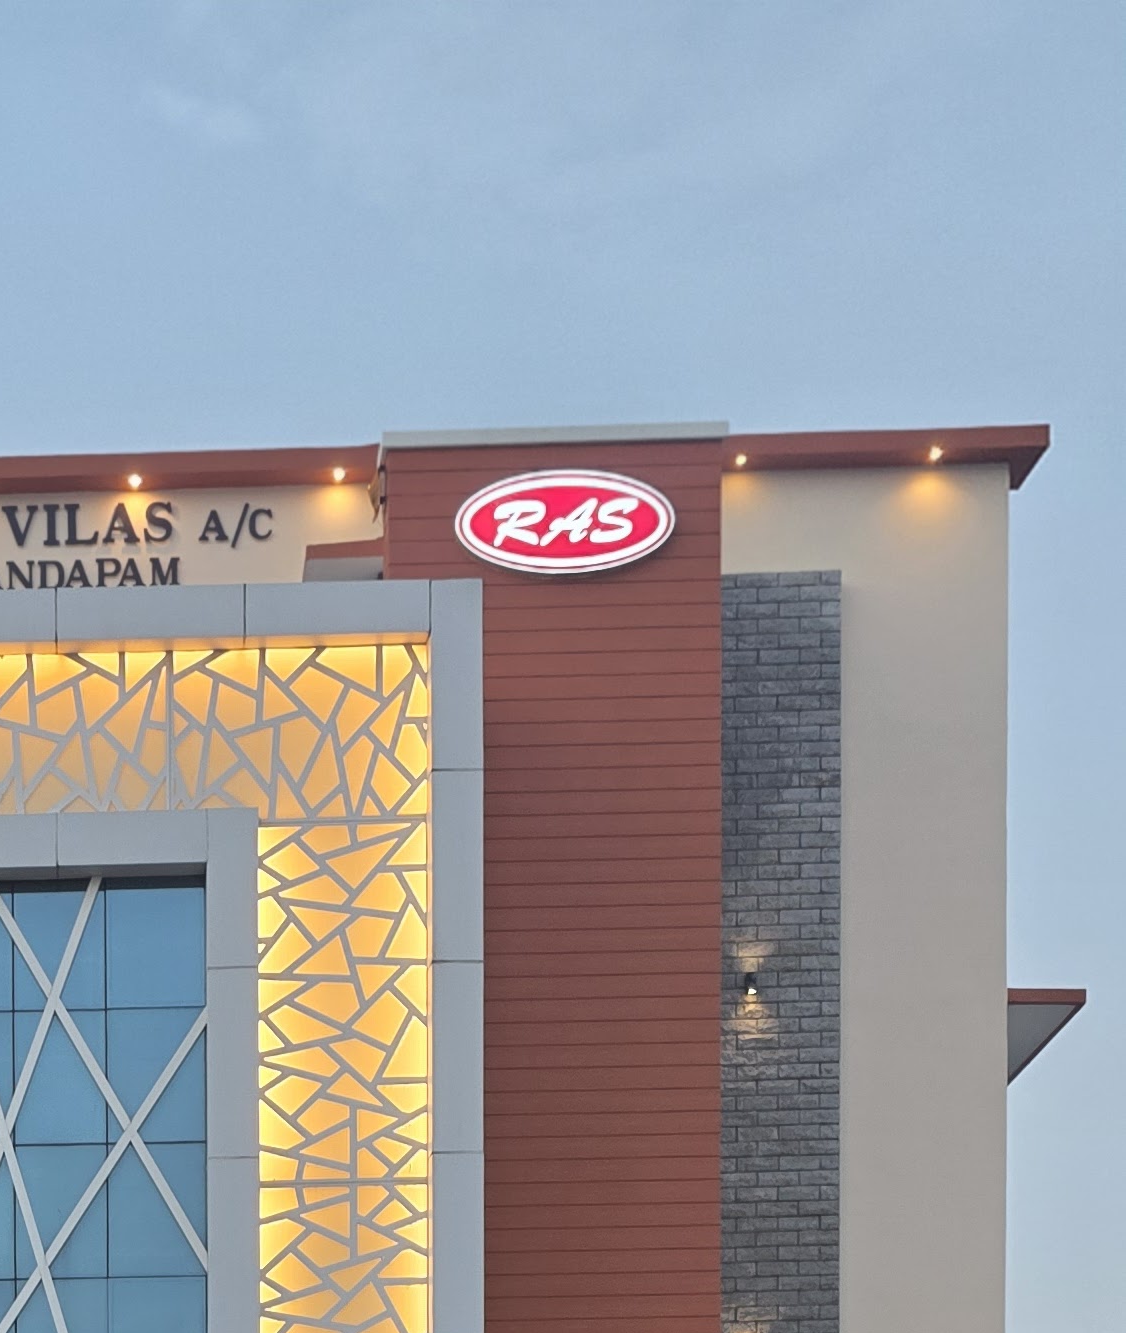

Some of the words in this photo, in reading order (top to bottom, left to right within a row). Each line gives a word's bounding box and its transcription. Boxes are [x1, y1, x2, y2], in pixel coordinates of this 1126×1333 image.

[2, 502, 173, 548] VILAS
[199, 502, 273, 549] A/C
[493, 497, 639, 547] RAS
